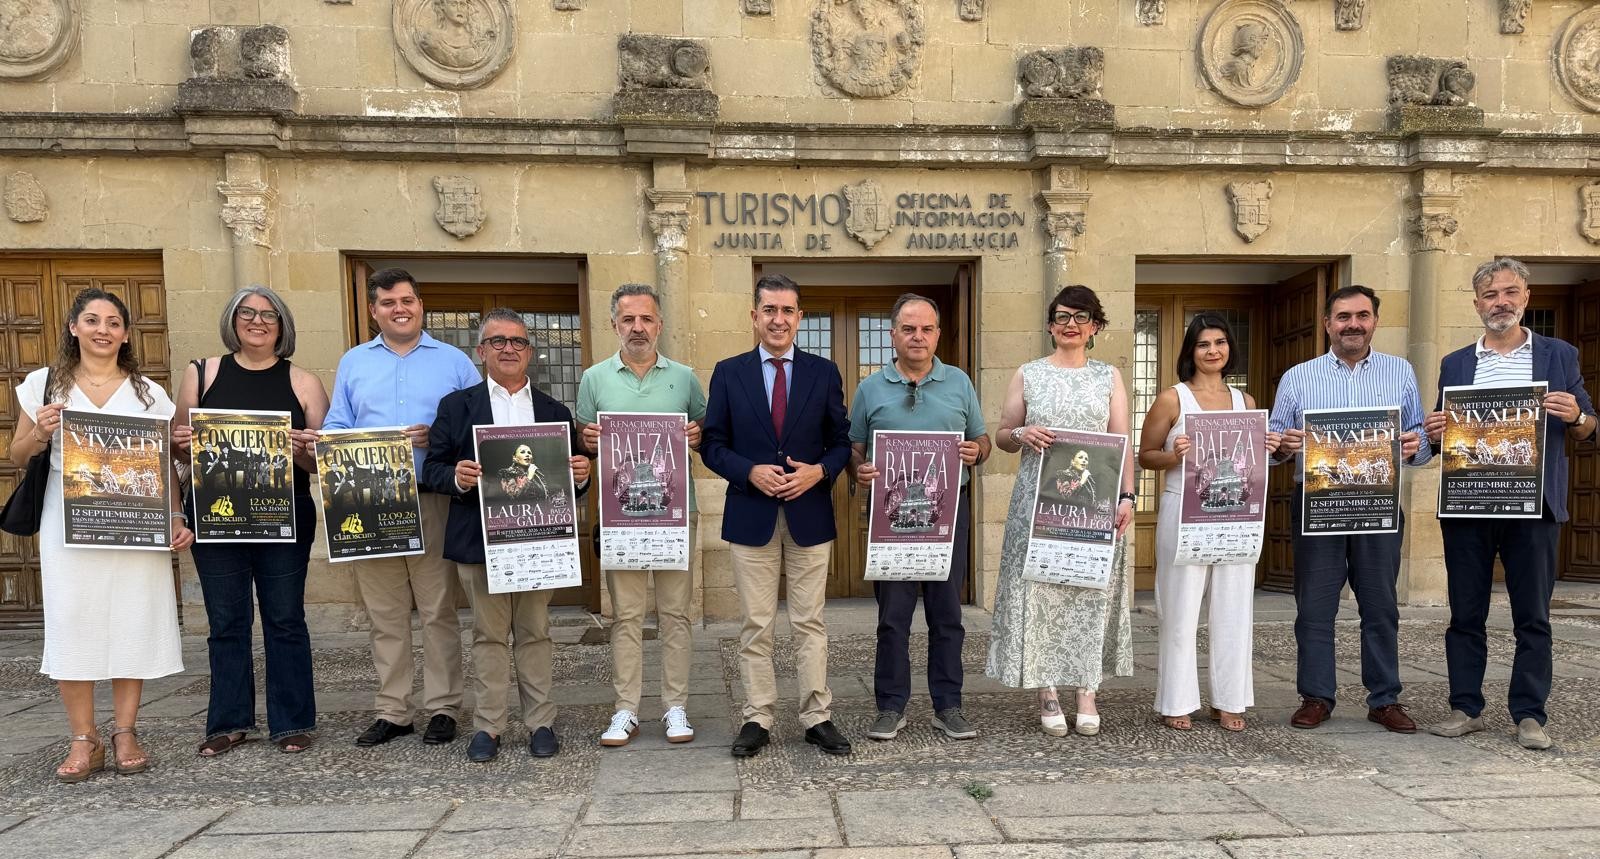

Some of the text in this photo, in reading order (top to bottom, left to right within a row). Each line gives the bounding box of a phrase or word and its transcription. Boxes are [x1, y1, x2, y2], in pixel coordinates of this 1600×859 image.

[896, 192, 1012, 209] OFICINA DE
[696, 192, 842, 226] TURISMO
[895, 211, 1025, 228] INFORMACION
[714, 233, 831, 250] JUNTA DE
[906, 232, 1019, 250] ANDALUCIA
[1450, 401, 1492, 410] CUARTETO
[1506, 398, 1540, 408] CUERDA
[1194, 418, 1256, 426] RENACIMIENTO
[1450, 406, 1540, 423] VIVALDI
[69, 423, 163, 438] CUARTETO DE CUERDA
[1311, 422, 1350, 432] CUARTETO
[70, 432, 164, 453] VIVALDI
[198, 429, 287, 448] CONCIERTO
[1311, 428, 1395, 444] VIVALDI
[324, 445, 408, 467] CONCIERTO
[610, 432, 676, 469] BAEZA
[1195, 430, 1256, 466] BAEZA
[884, 452, 948, 489] BAEZA
[250, 498, 290, 507] 12.09.26
[487, 503, 543, 518] LAURA
[1038, 502, 1088, 518] LAURA
[1319, 499, 1372, 507] SEPTIEMBRE
[82, 509, 141, 519] SEPTIEMBRE
[142, 512, 164, 520] 2026
[378, 512, 416, 521] 12.09.26
[516, 513, 572, 527] GALLEGO
[1062, 516, 1112, 530] GALLEGO
